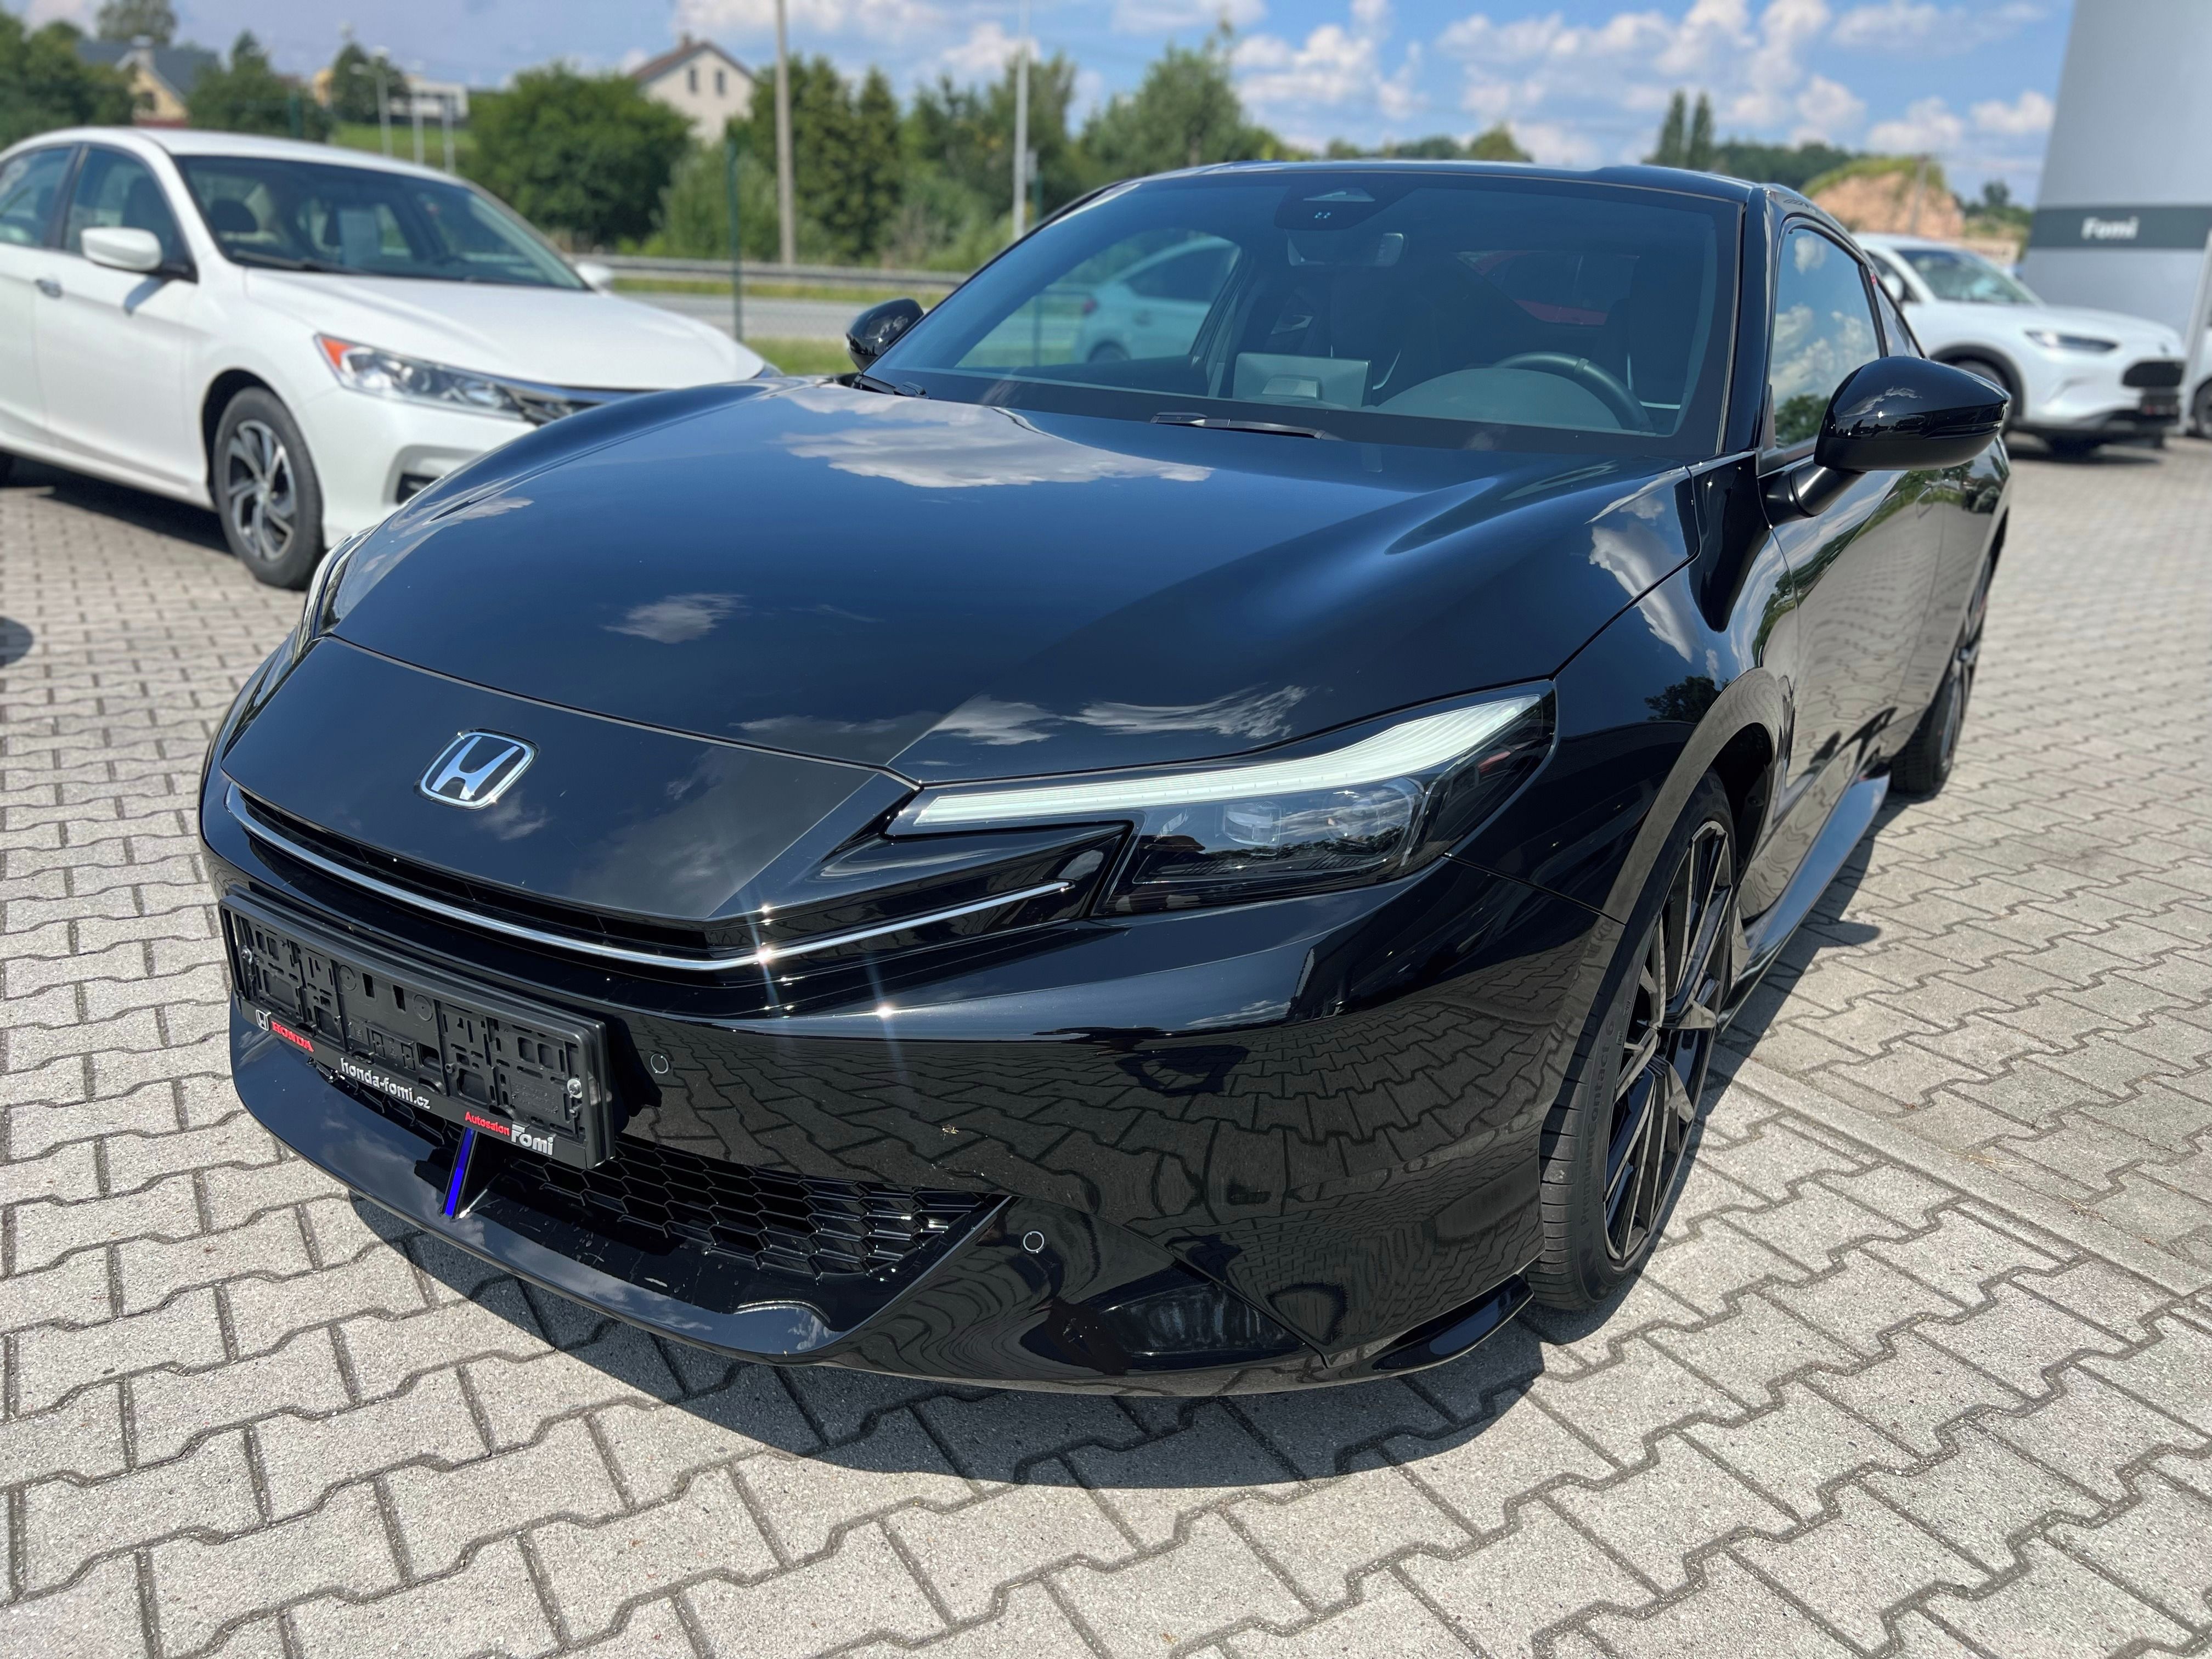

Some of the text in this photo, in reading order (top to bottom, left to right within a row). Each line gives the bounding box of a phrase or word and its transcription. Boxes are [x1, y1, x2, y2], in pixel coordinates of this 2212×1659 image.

[2081, 216, 2138, 239] Fomi
[272, 1021, 314, 1053] HONDA
[341, 1058, 430, 1110] honda-fomi.cz
[465, 1111, 553, 1155] Autosalon Fomi
[1581, 1045, 1610, 1226] PremiumContact
[1606, 1020, 1615, 1036] 6
